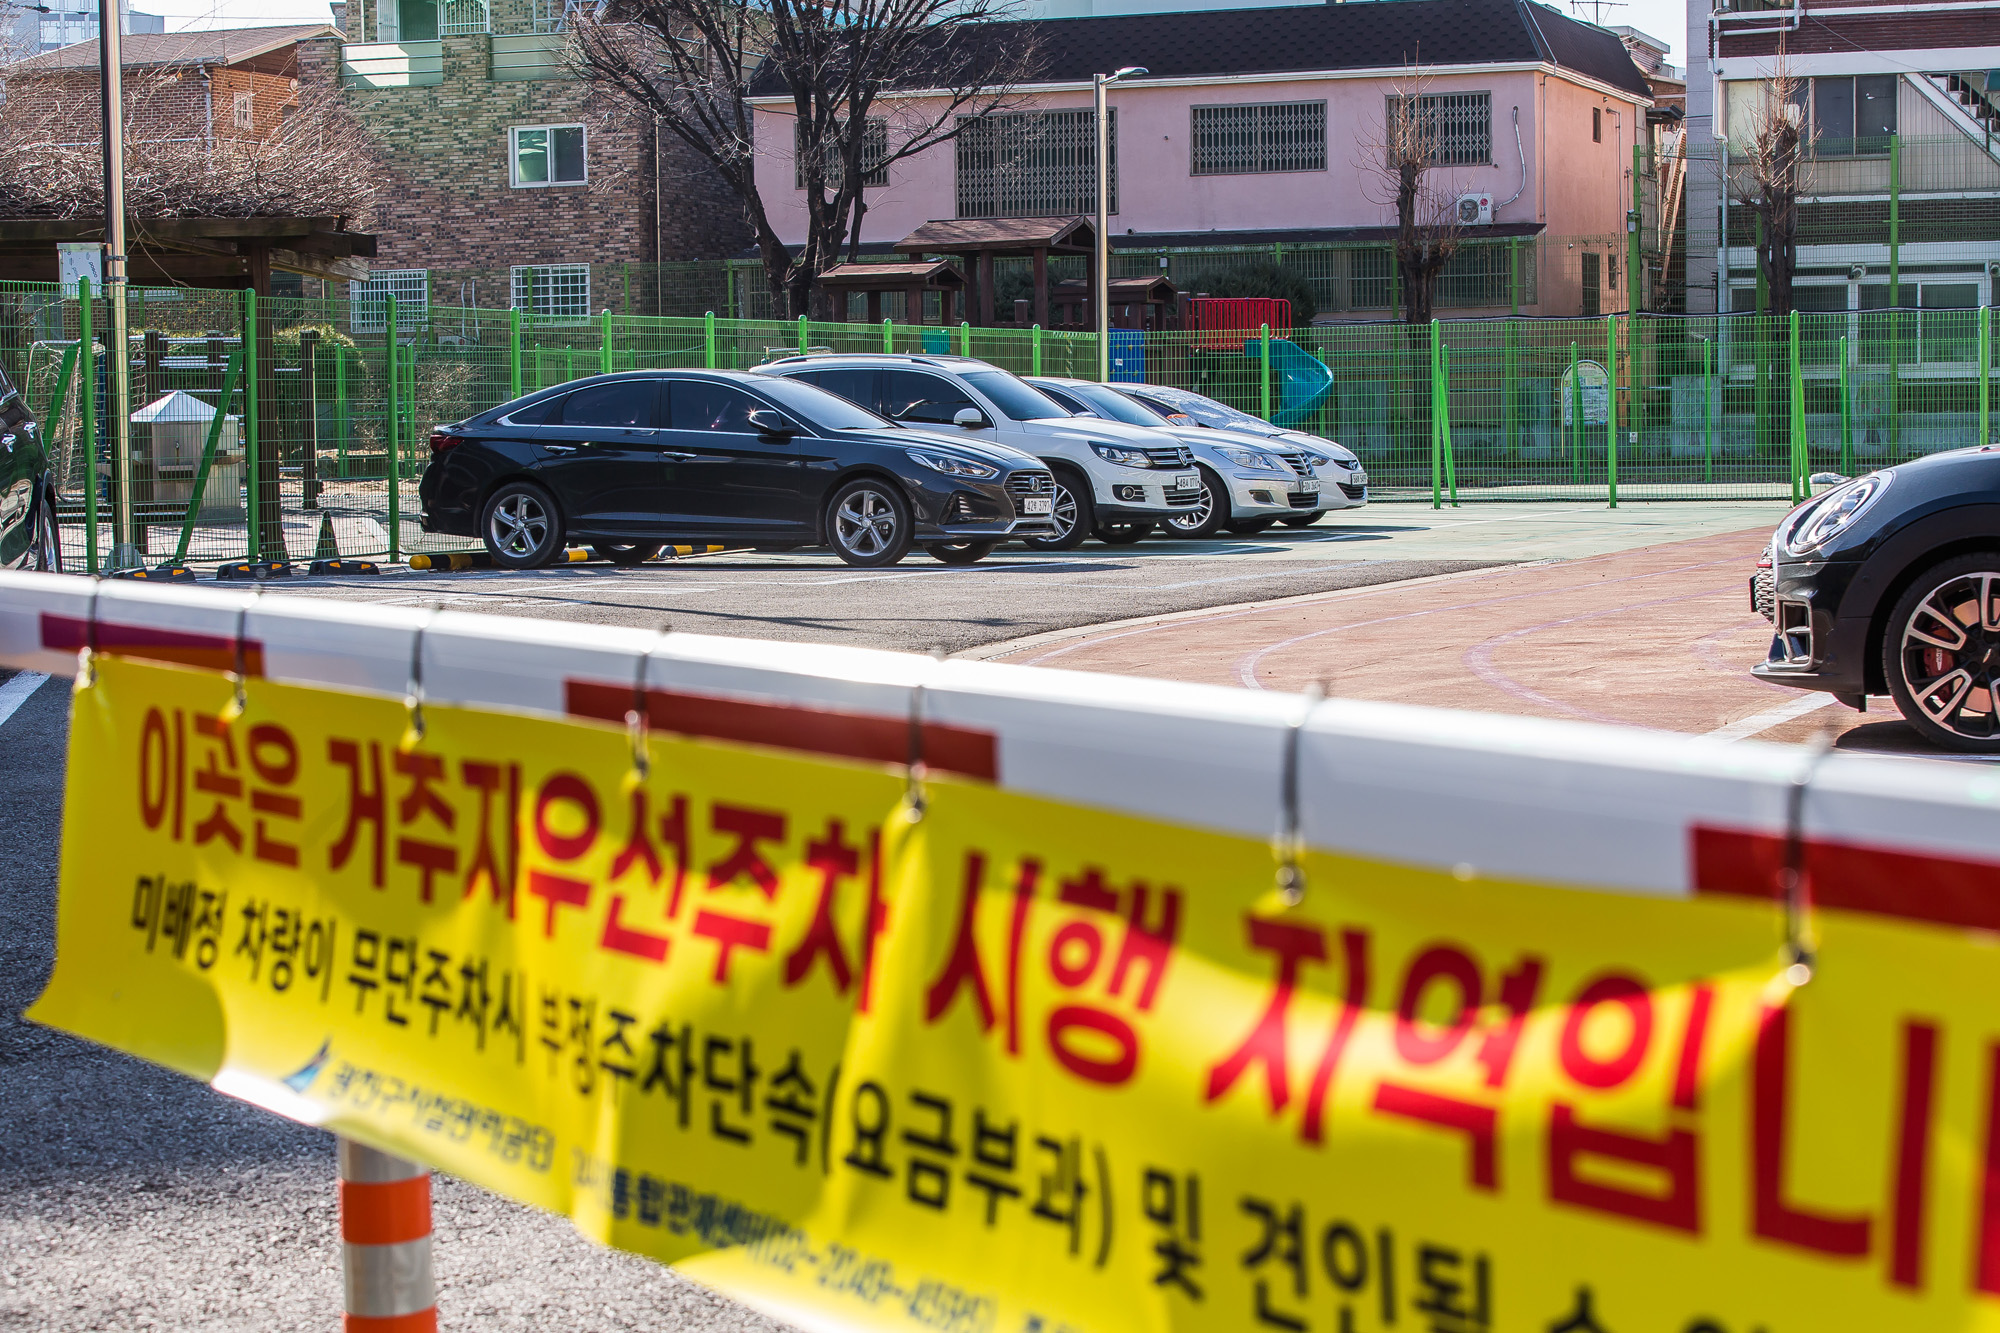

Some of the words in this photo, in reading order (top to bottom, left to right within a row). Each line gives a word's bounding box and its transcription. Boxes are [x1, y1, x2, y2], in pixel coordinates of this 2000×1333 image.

[89, 261, 97, 277] posco
[130, 871, 227, 970] 미배정
[234, 895, 337, 1004] 차량이
[347, 924, 526, 1066] 무단주차시
[1141, 1165, 1207, 1304] 및
[138, 705, 304, 870] 이곳은
[326, 735, 890, 1017] 거주자우선주차
[924, 845, 1187, 1090] 시행
[1202, 905, 2000, 1298] 지역입니
